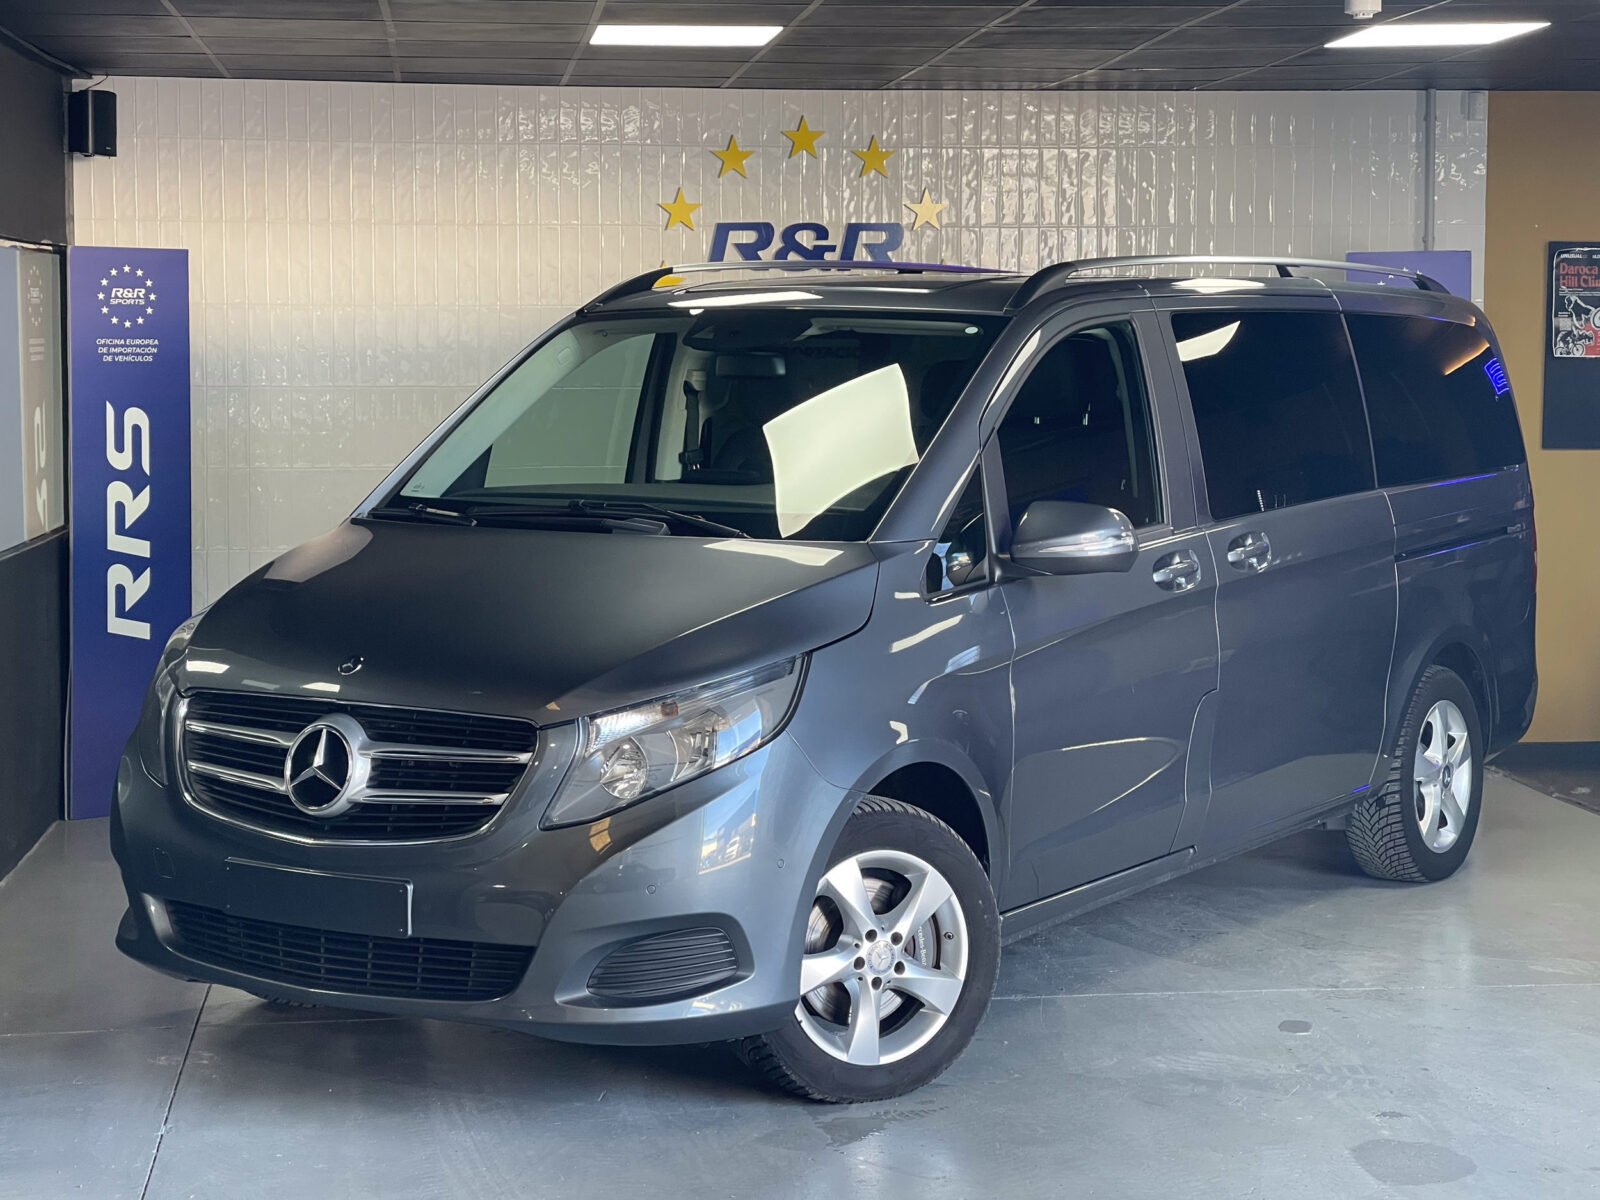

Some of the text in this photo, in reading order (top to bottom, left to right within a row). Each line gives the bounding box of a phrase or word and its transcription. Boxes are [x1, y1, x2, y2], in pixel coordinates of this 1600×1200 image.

[707, 222, 904, 271] R&R
[1560, 262, 1599, 275] Daroca
[1560, 276, 1578, 288] Hill
[111, 287, 146, 299] R&R
[109, 345, 158, 353] IMPORTACIÓN
[114, 353, 153, 362] VEHÍCULOS
[106, 400, 151, 640] RRS
